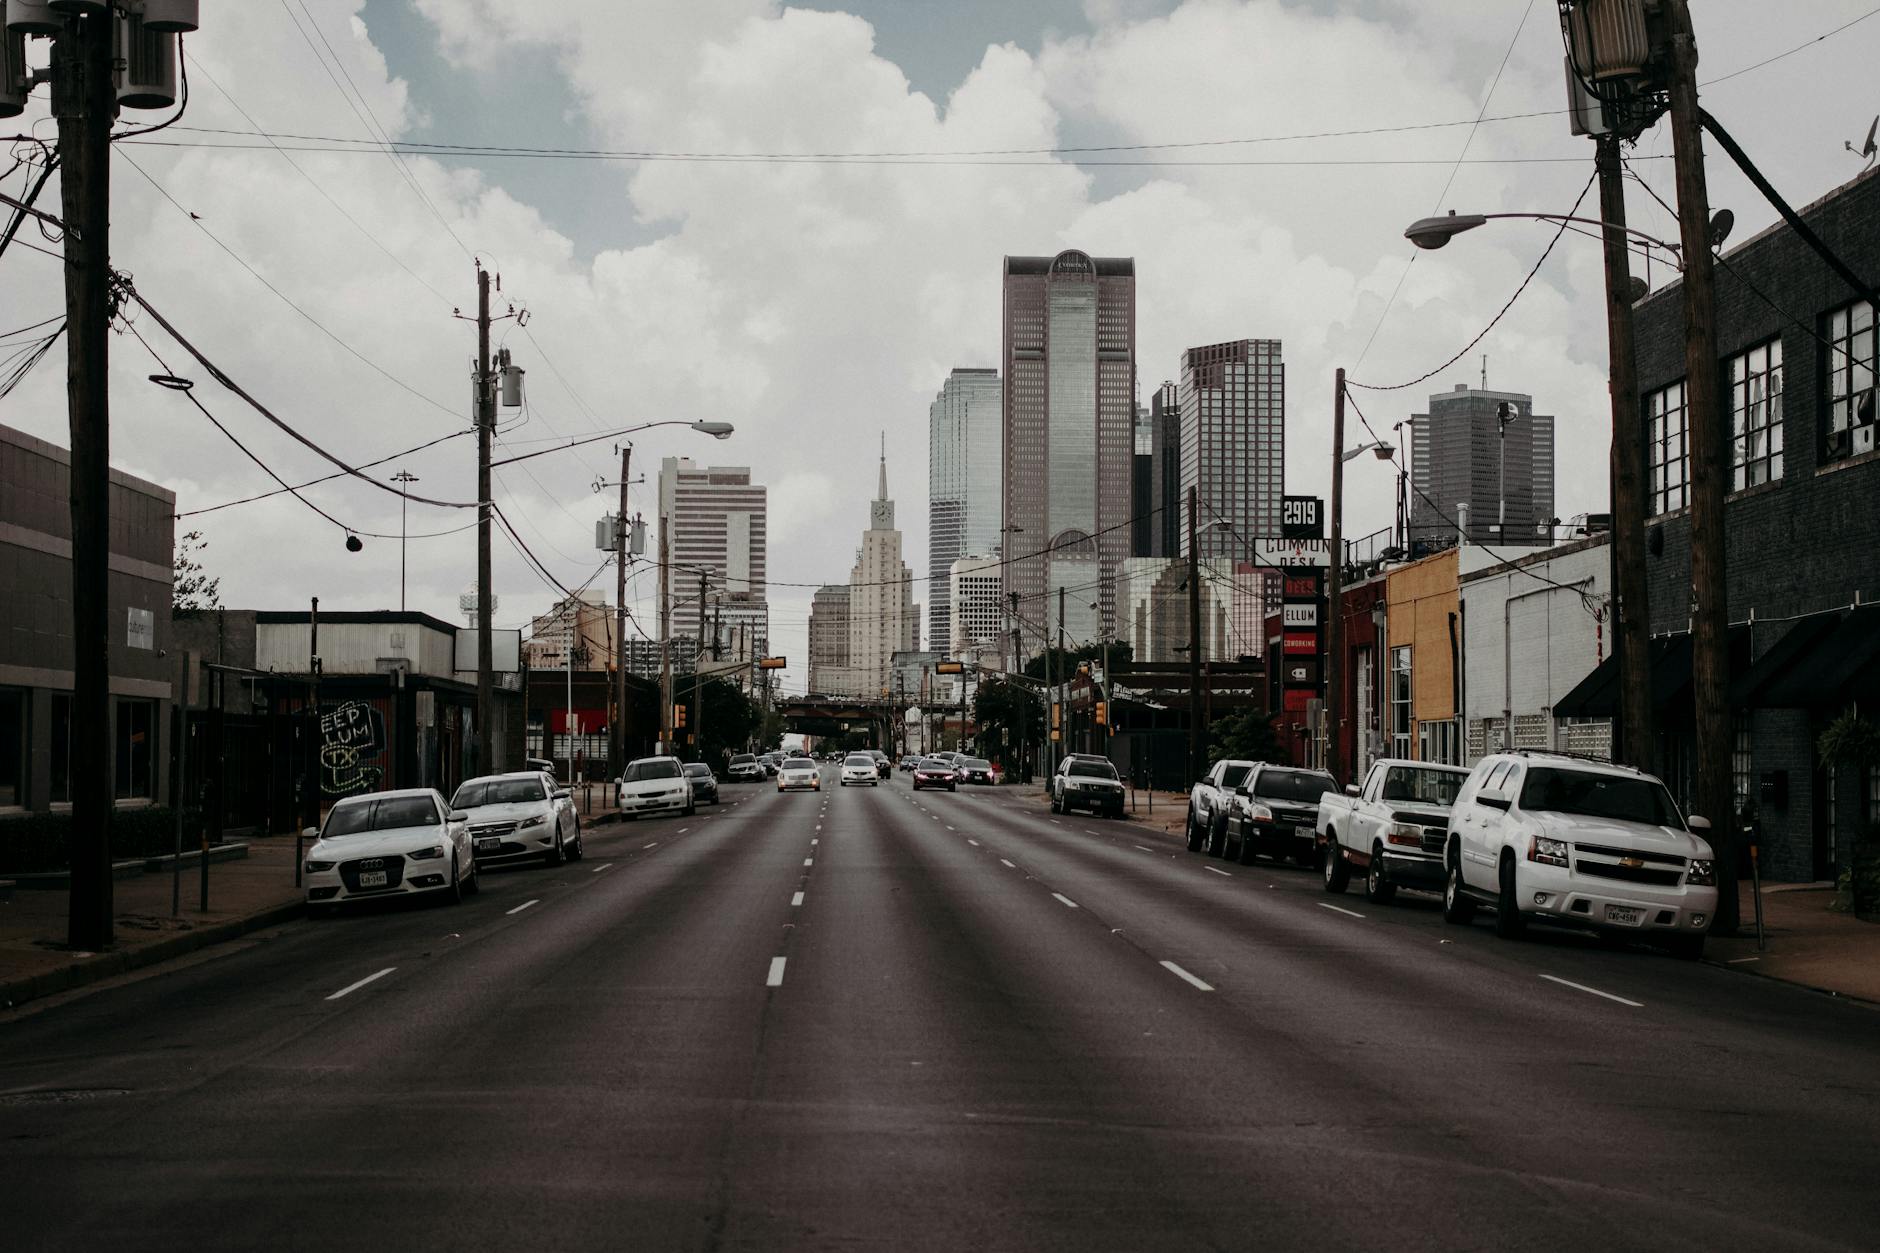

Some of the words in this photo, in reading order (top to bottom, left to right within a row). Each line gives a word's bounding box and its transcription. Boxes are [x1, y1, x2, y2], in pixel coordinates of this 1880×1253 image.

[1284, 501, 1316, 525] 2919
[1266, 539, 1331, 554] COMMON
[1281, 557, 1316, 567] DESK
[1286, 610, 1314, 621] ELLUM
[1284, 639, 1316, 647] COWORKING
[321, 708, 360, 733] EEP
[325, 724, 369, 746] LUM
